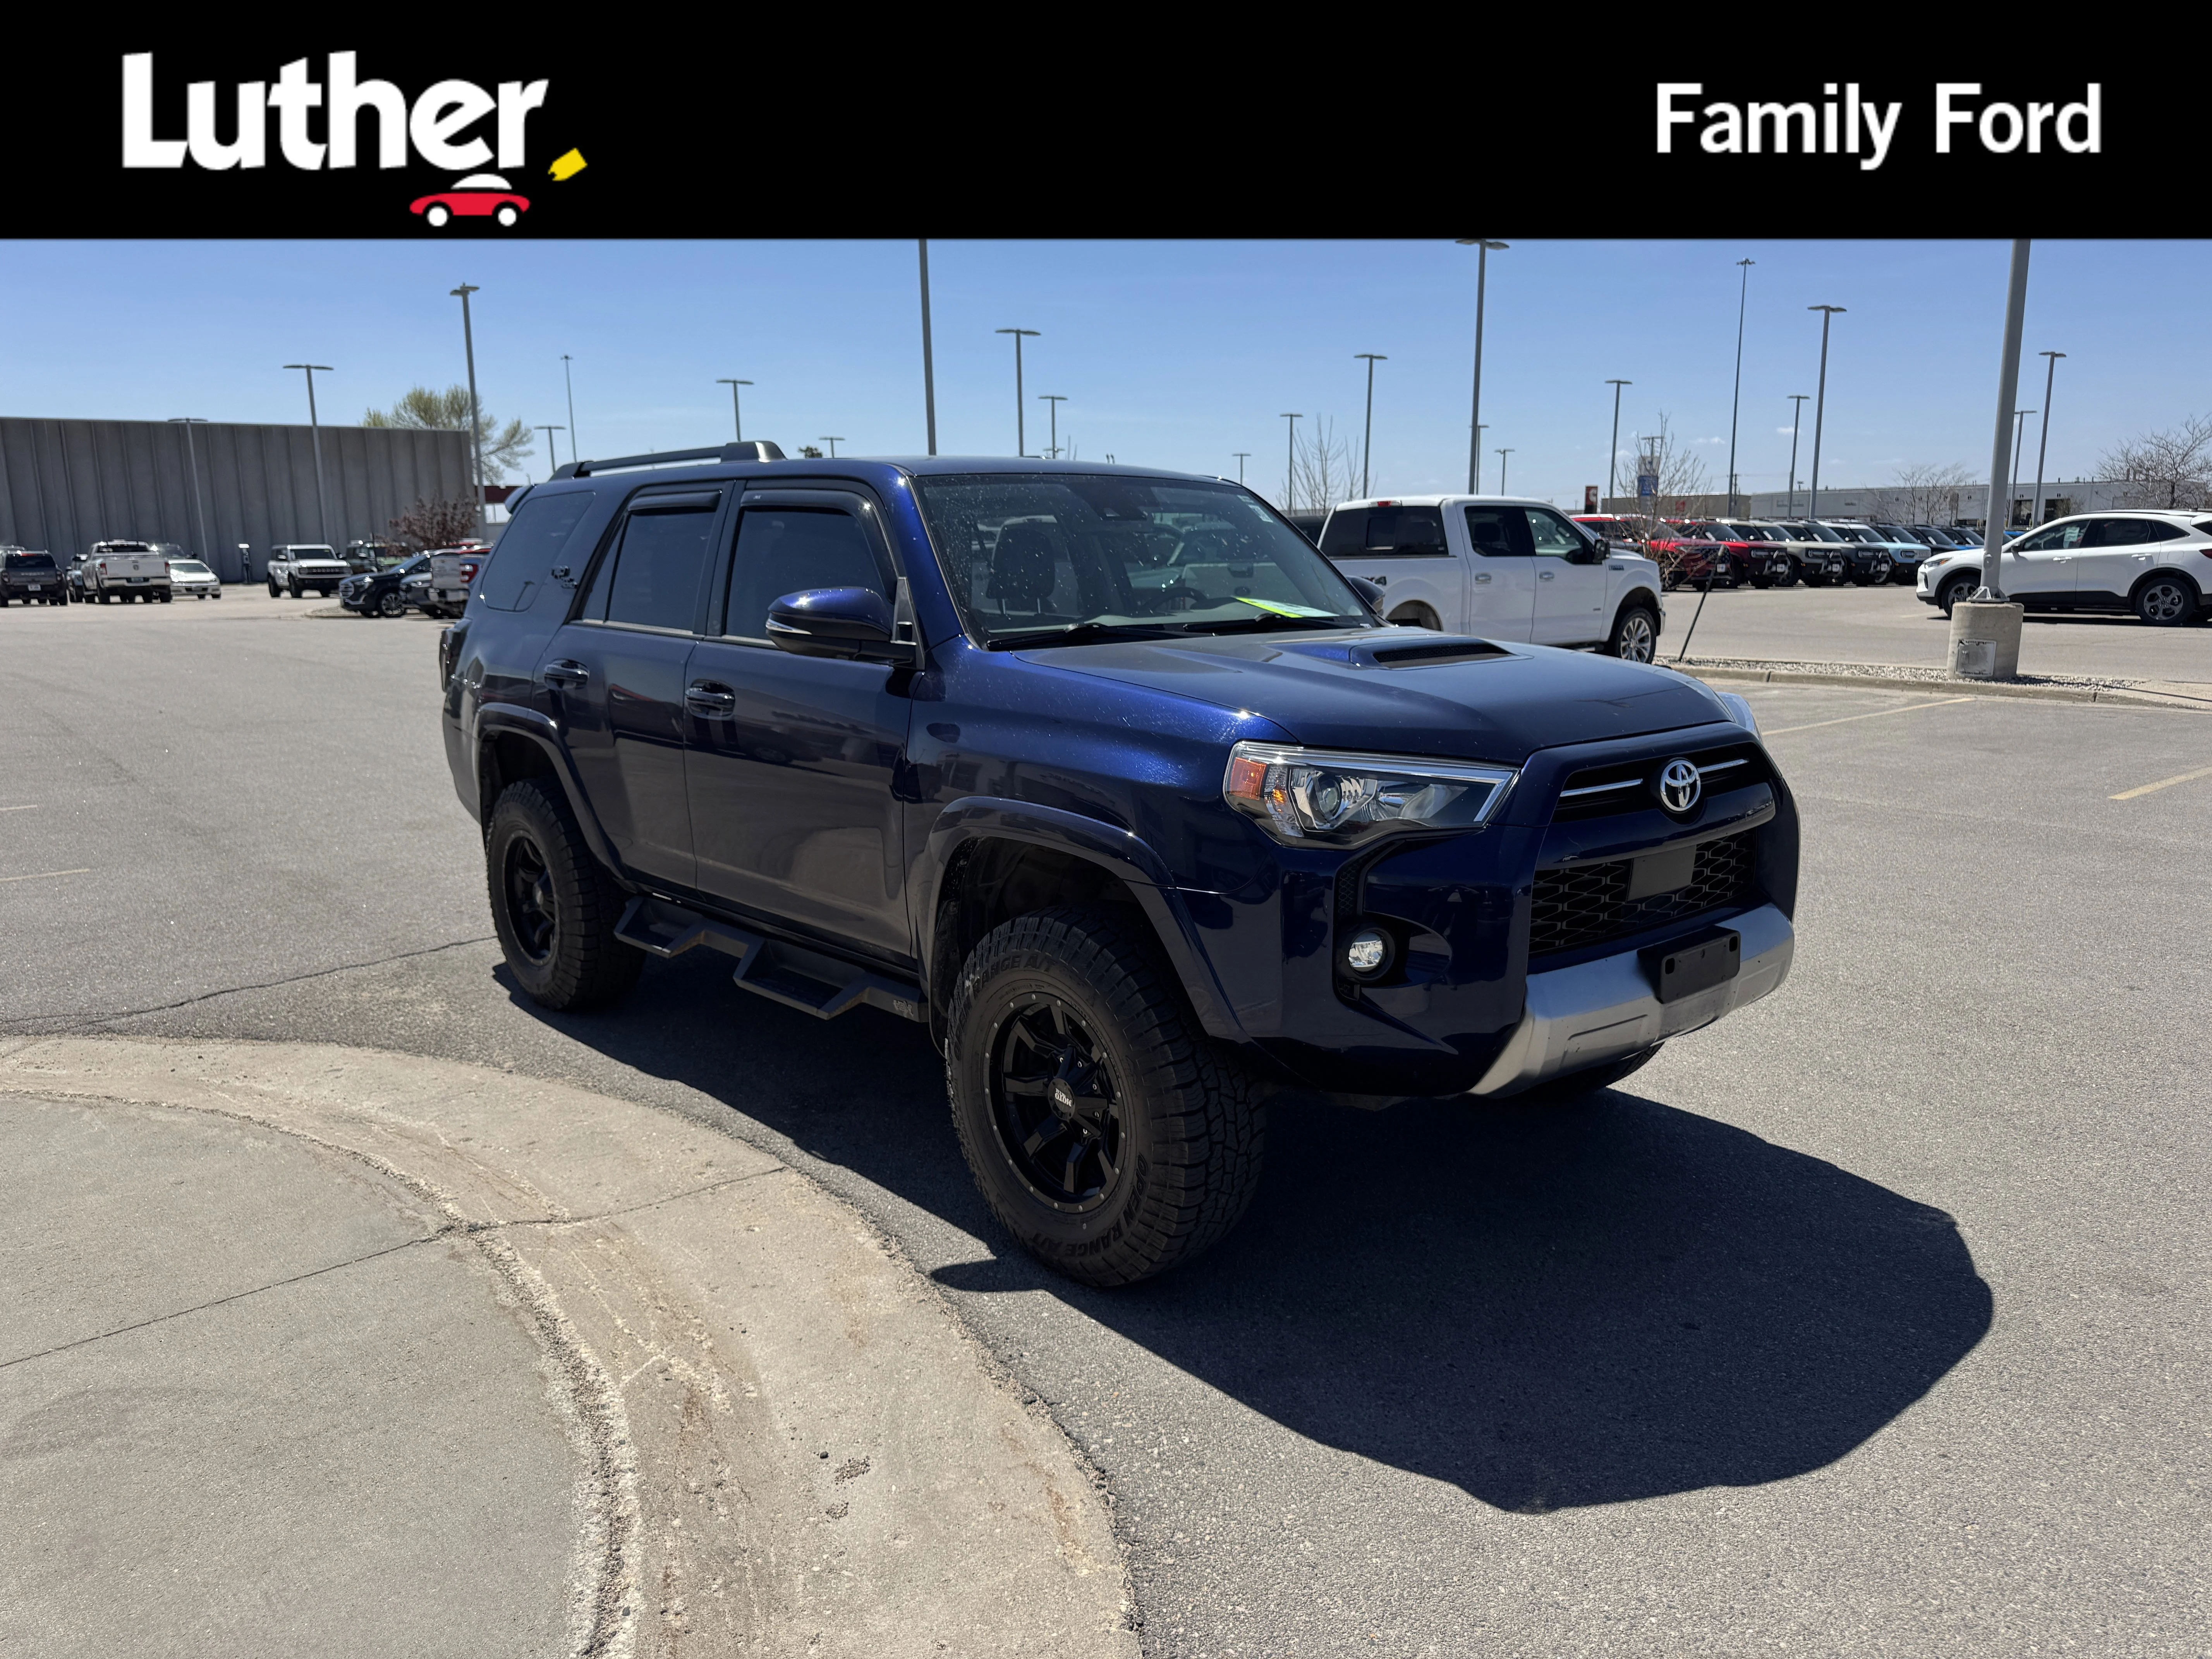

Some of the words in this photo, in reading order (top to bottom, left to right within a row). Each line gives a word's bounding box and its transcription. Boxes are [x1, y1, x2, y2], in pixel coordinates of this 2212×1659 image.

[1054, 1092, 1072, 1107] MOTO
[1123, 1153, 1148, 1228] OPEN
[1066, 1218, 1123, 1256] RANGE
